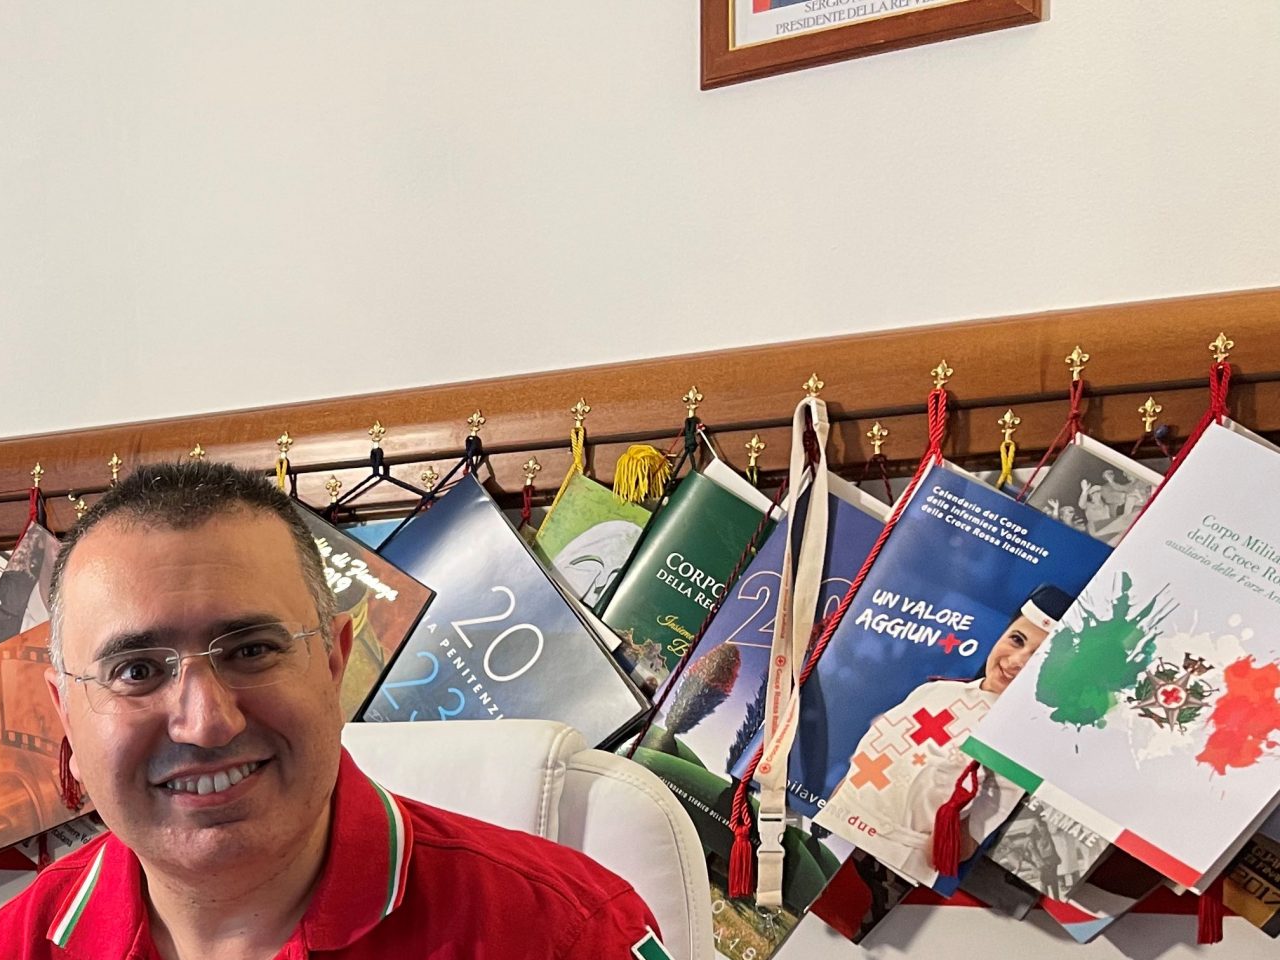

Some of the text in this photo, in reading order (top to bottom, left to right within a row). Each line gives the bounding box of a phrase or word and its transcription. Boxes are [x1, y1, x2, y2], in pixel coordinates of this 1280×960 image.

[776, 10, 845, 35] PRESIDENTE
[847, 2, 889, 20] DELLA
[926, 495, 1050, 558] delle Infermiere Volontarie
[932, 485, 1028, 536] Calendario del Corpo
[1202, 514, 1241, 542] Corpo
[921, 504, 1040, 565] della Croce Rossa Italiana
[1186, 528, 1220, 553] della
[1222, 545, 1261, 573] Croce
[655, 568, 693, 599] DELLA
[1211, 562, 1238, 579] delle
[872, 588, 974, 632] UN VALORE
[451, 585, 544, 682] 20
[1040, 804, 1100, 848] ARMATE
